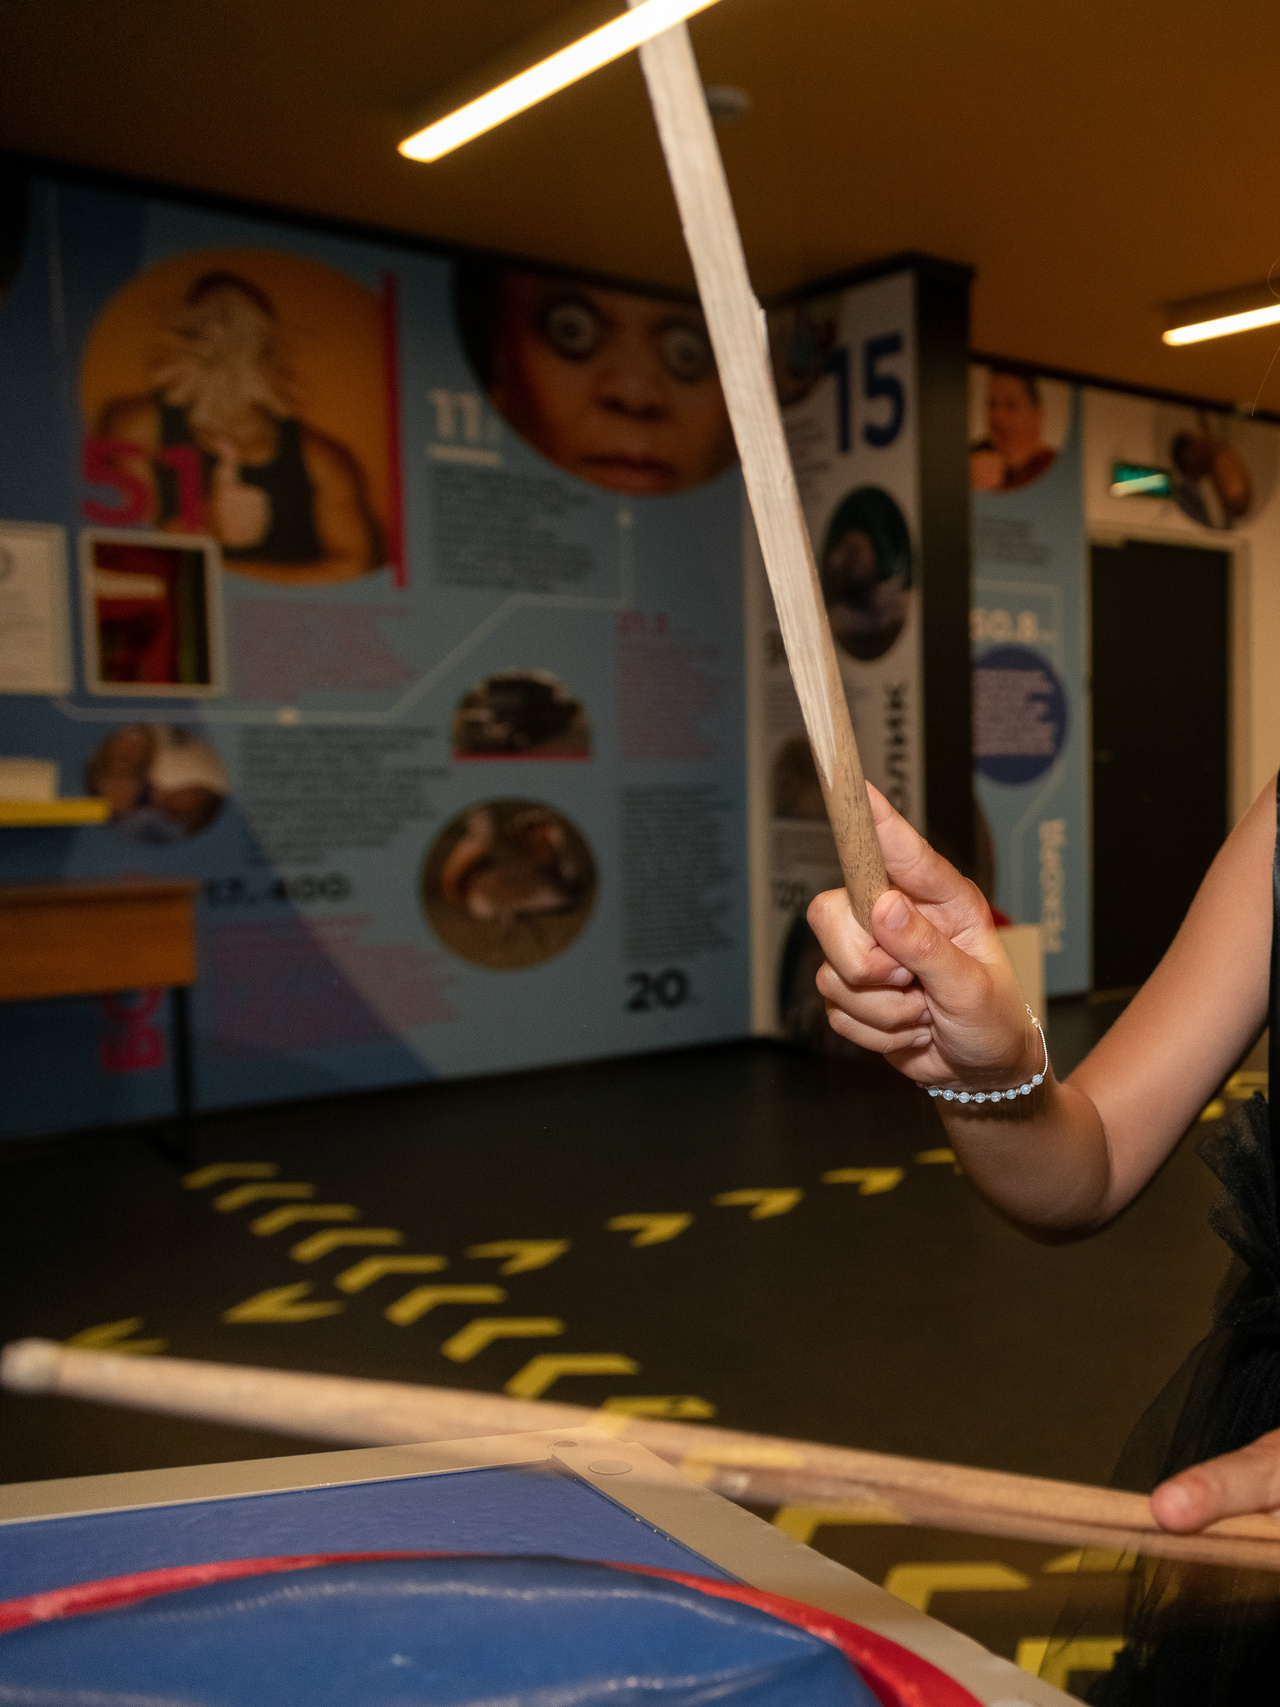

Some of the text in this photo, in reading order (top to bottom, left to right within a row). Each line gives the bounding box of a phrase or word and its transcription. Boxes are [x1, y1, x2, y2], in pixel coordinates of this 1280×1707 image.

[823, 332, 905, 453] 15
[79, 437, 211, 532] 51
[626, 970, 690, 1013] 20
